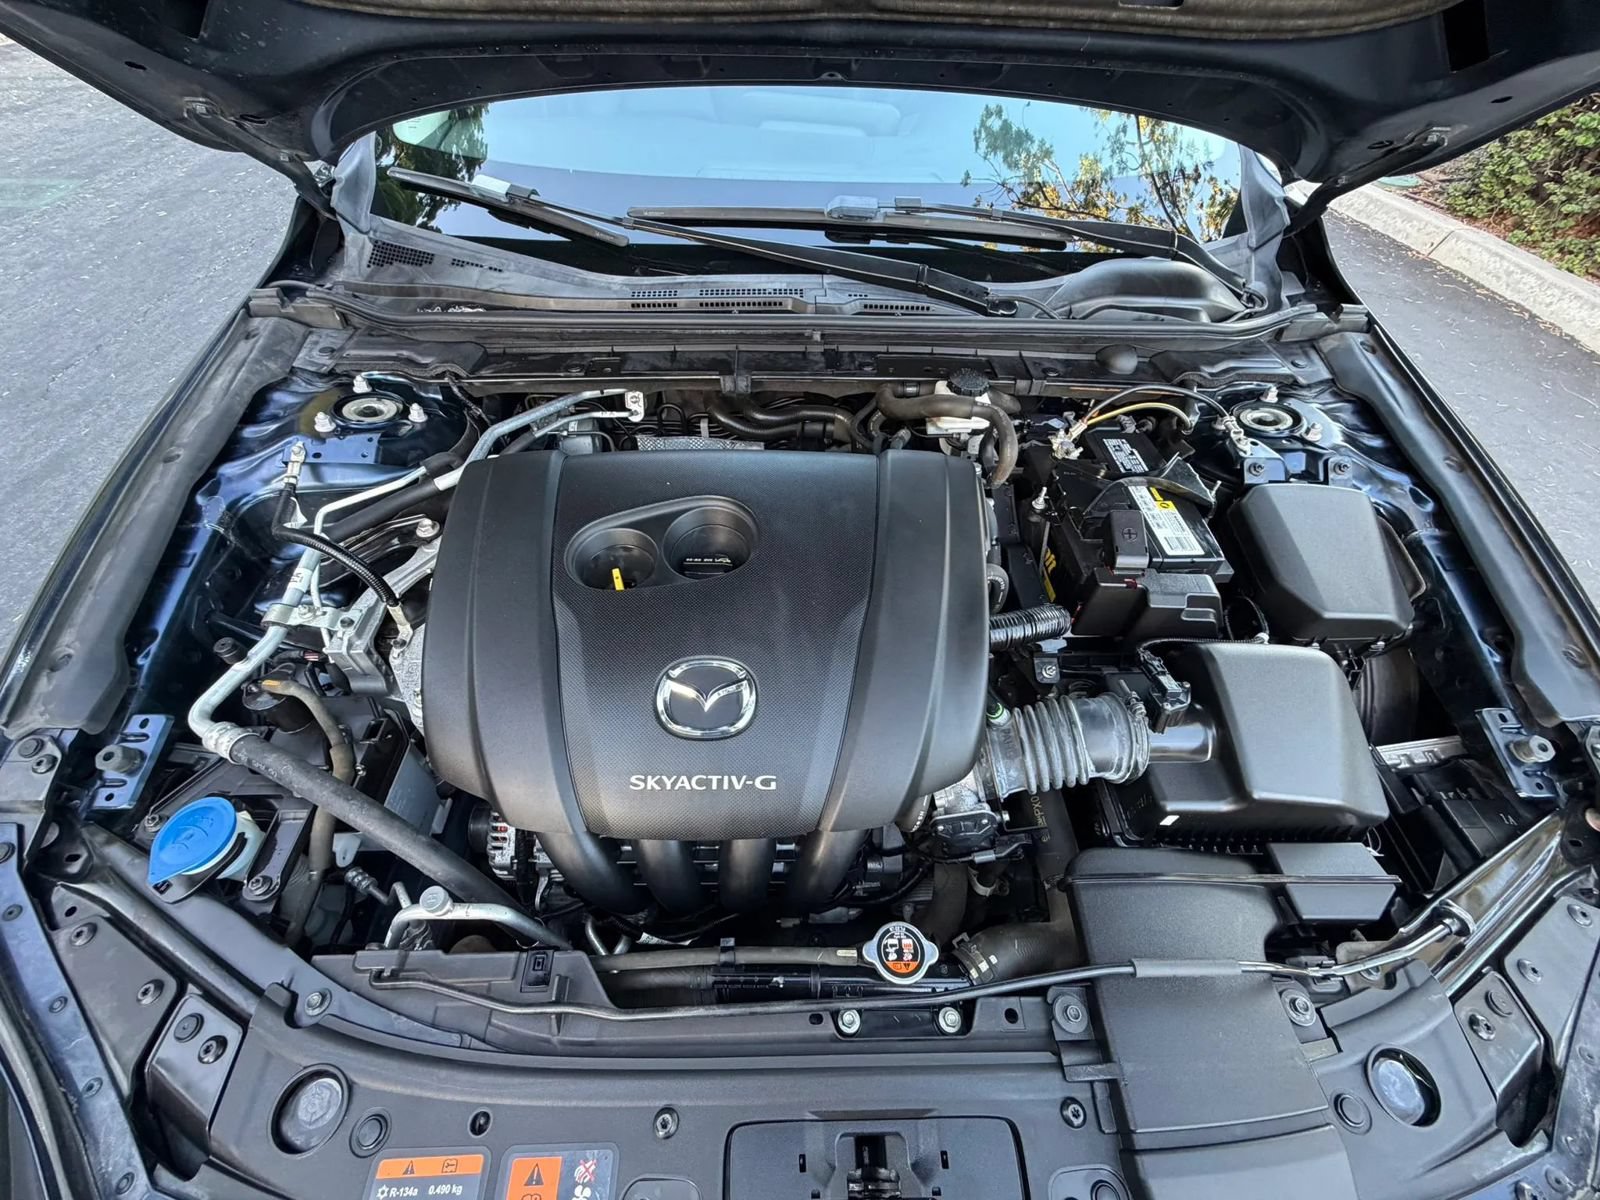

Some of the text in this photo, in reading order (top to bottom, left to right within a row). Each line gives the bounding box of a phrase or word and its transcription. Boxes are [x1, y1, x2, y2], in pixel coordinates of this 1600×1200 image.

[629, 774, 777, 791] SKYACTIV-G
[389, 1184, 463, 1198] R-134a 0.490 kg
